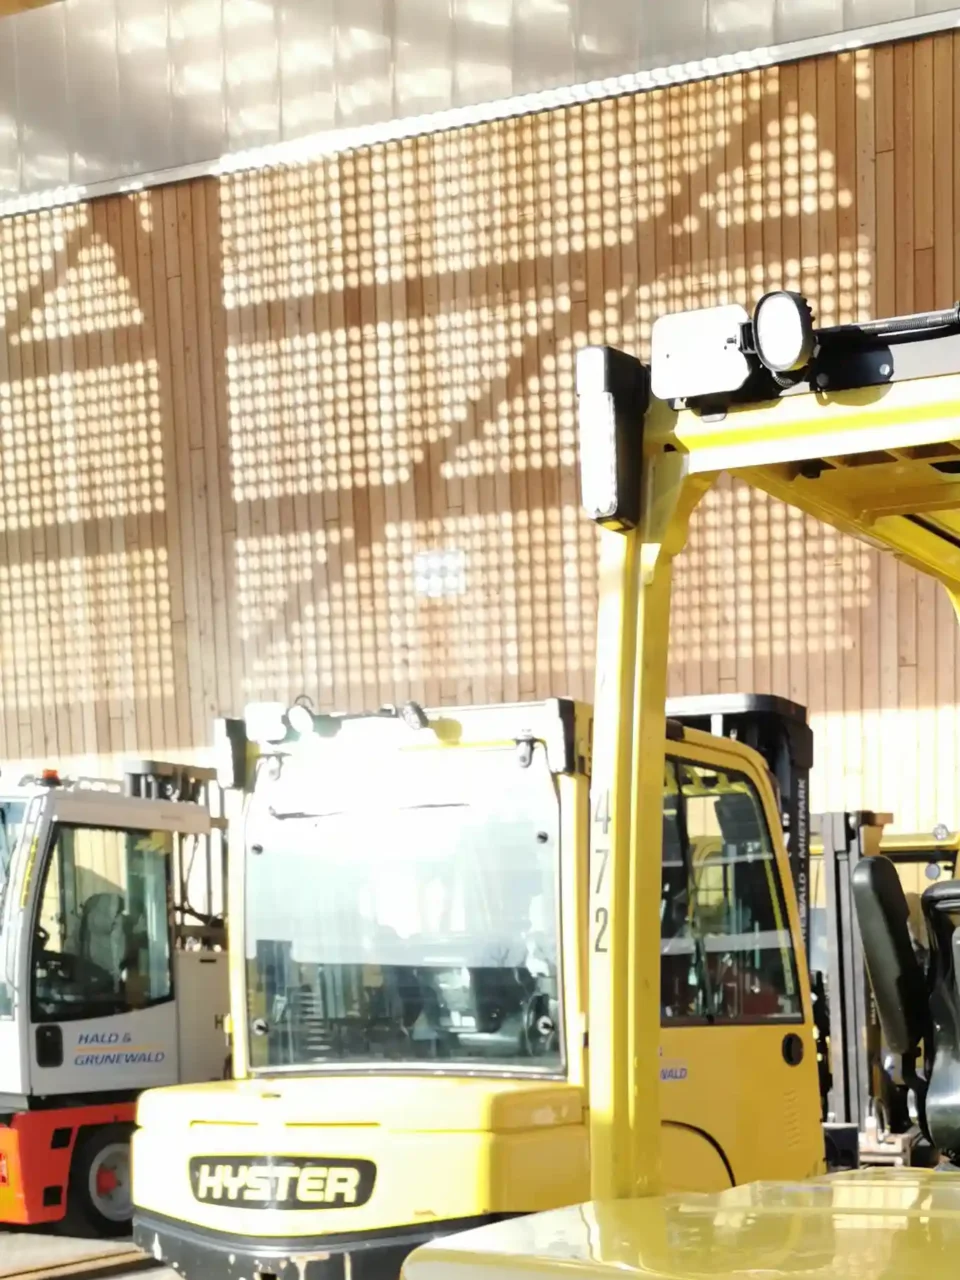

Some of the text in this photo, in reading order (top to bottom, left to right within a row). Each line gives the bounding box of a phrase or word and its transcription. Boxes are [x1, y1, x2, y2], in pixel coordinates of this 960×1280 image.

[798, 778, 806, 859] MIETPARK
[78, 1032, 132, 1044] HALD &
[74, 1051, 165, 1066] GRUNEWALD
[198, 1164, 360, 1203] HYSTER
